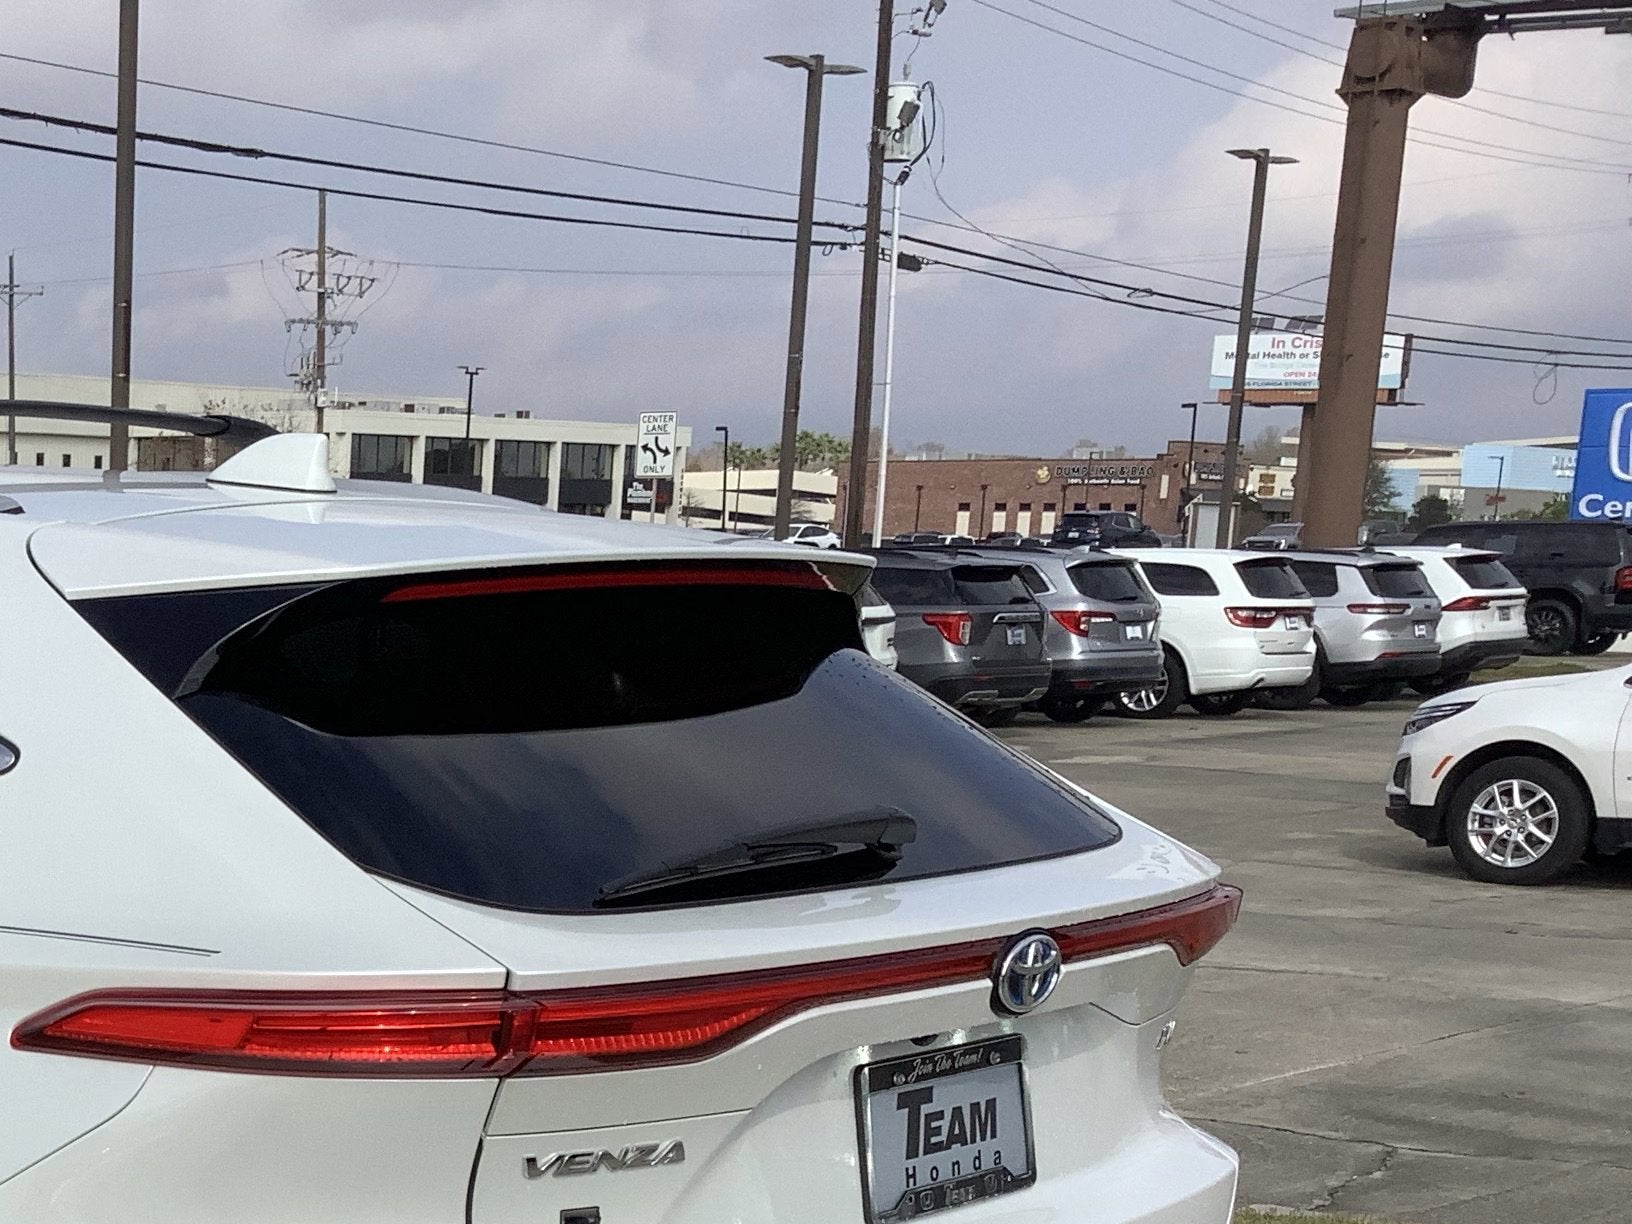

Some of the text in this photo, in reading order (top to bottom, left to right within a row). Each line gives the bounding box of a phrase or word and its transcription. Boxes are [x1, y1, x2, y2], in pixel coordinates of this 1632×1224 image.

[1271, 337, 1286, 349] In
[1224, 351, 1260, 360] Mal
[1262, 351, 1296, 359] Health
[642, 414, 674, 423] CENTER
[646, 424, 668, 432] LANE
[643, 465, 665, 474] ONLY
[1055, 466, 1154, 476] DUMPLING & BAO
[896, 1085, 997, 1161] TEAM
[522, 1135, 685, 1180] VENZA
[905, 1149, 1002, 1189] Honda
